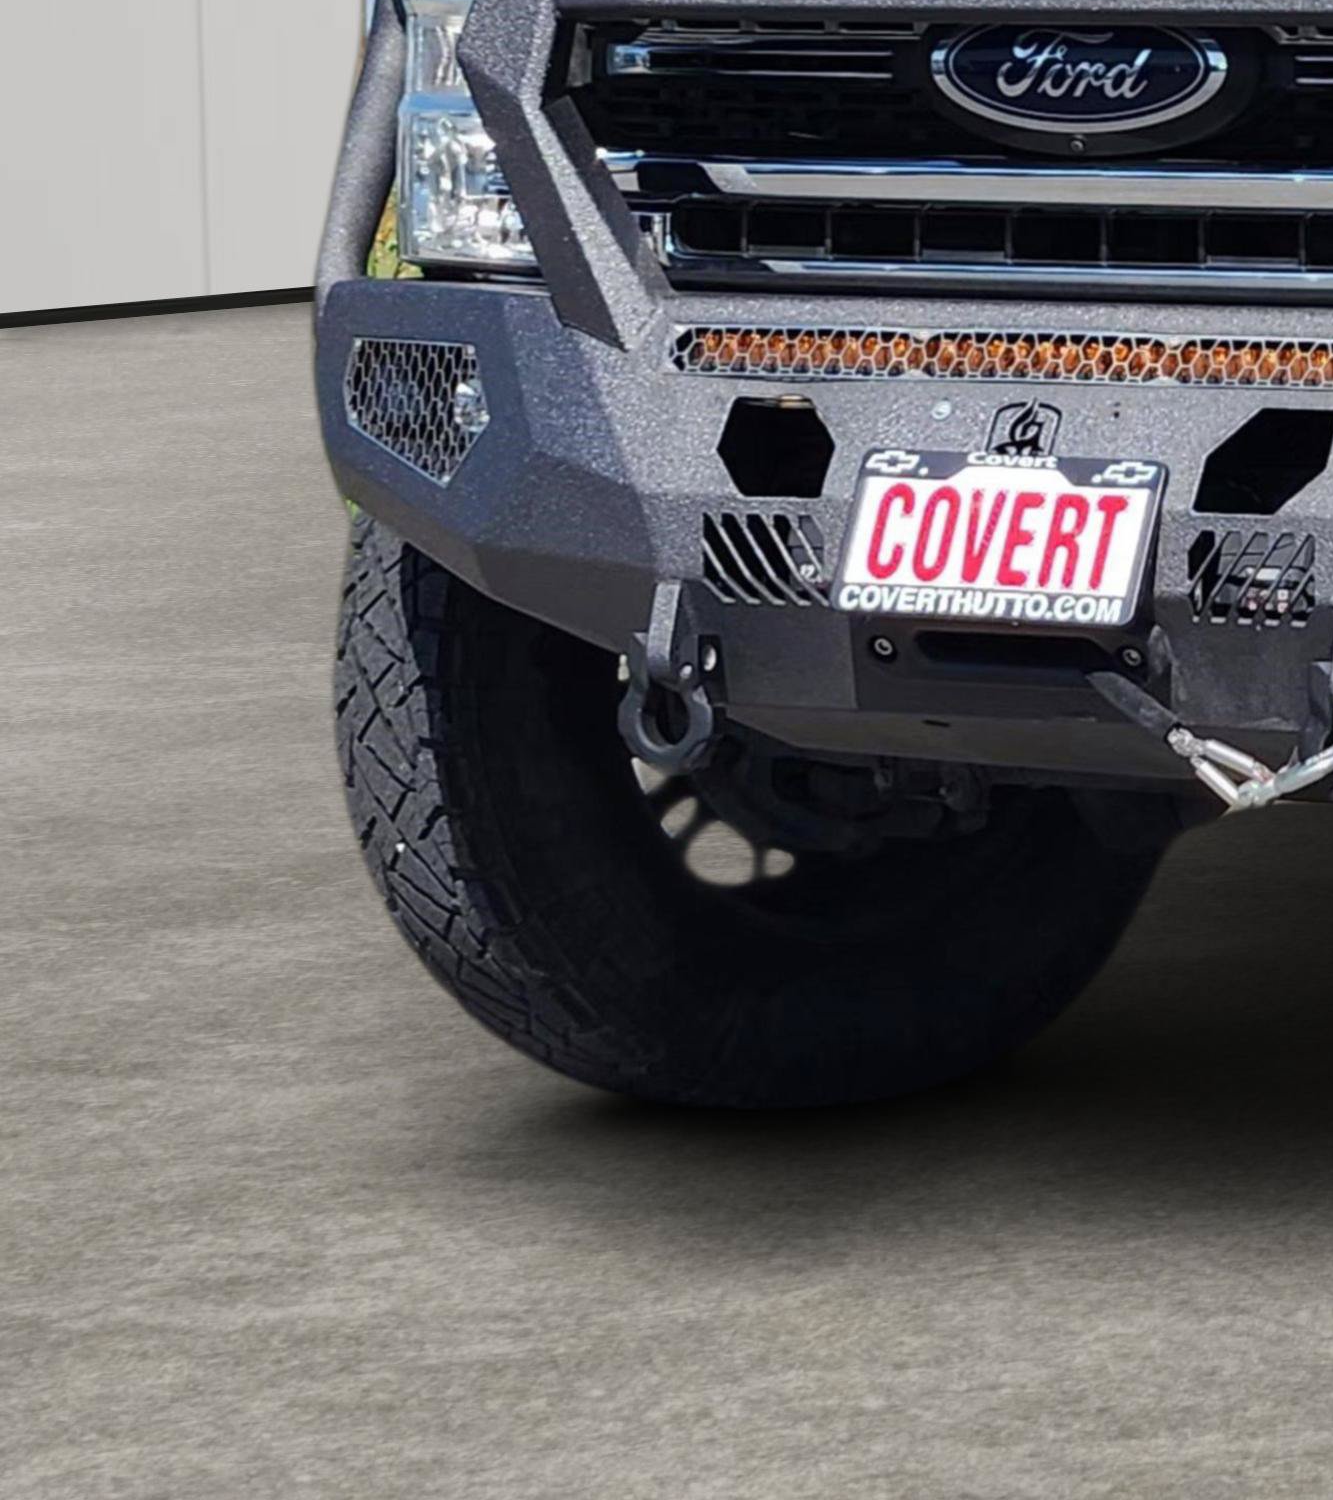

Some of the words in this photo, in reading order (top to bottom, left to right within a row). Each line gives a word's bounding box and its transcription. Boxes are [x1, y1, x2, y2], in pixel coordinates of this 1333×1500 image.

[996, 29, 1151, 99] Ford
[967, 450, 1059, 470] Covert
[866, 482, 1131, 591] COVERT
[838, 584, 1123, 624] COVERTHUTTO.COM
